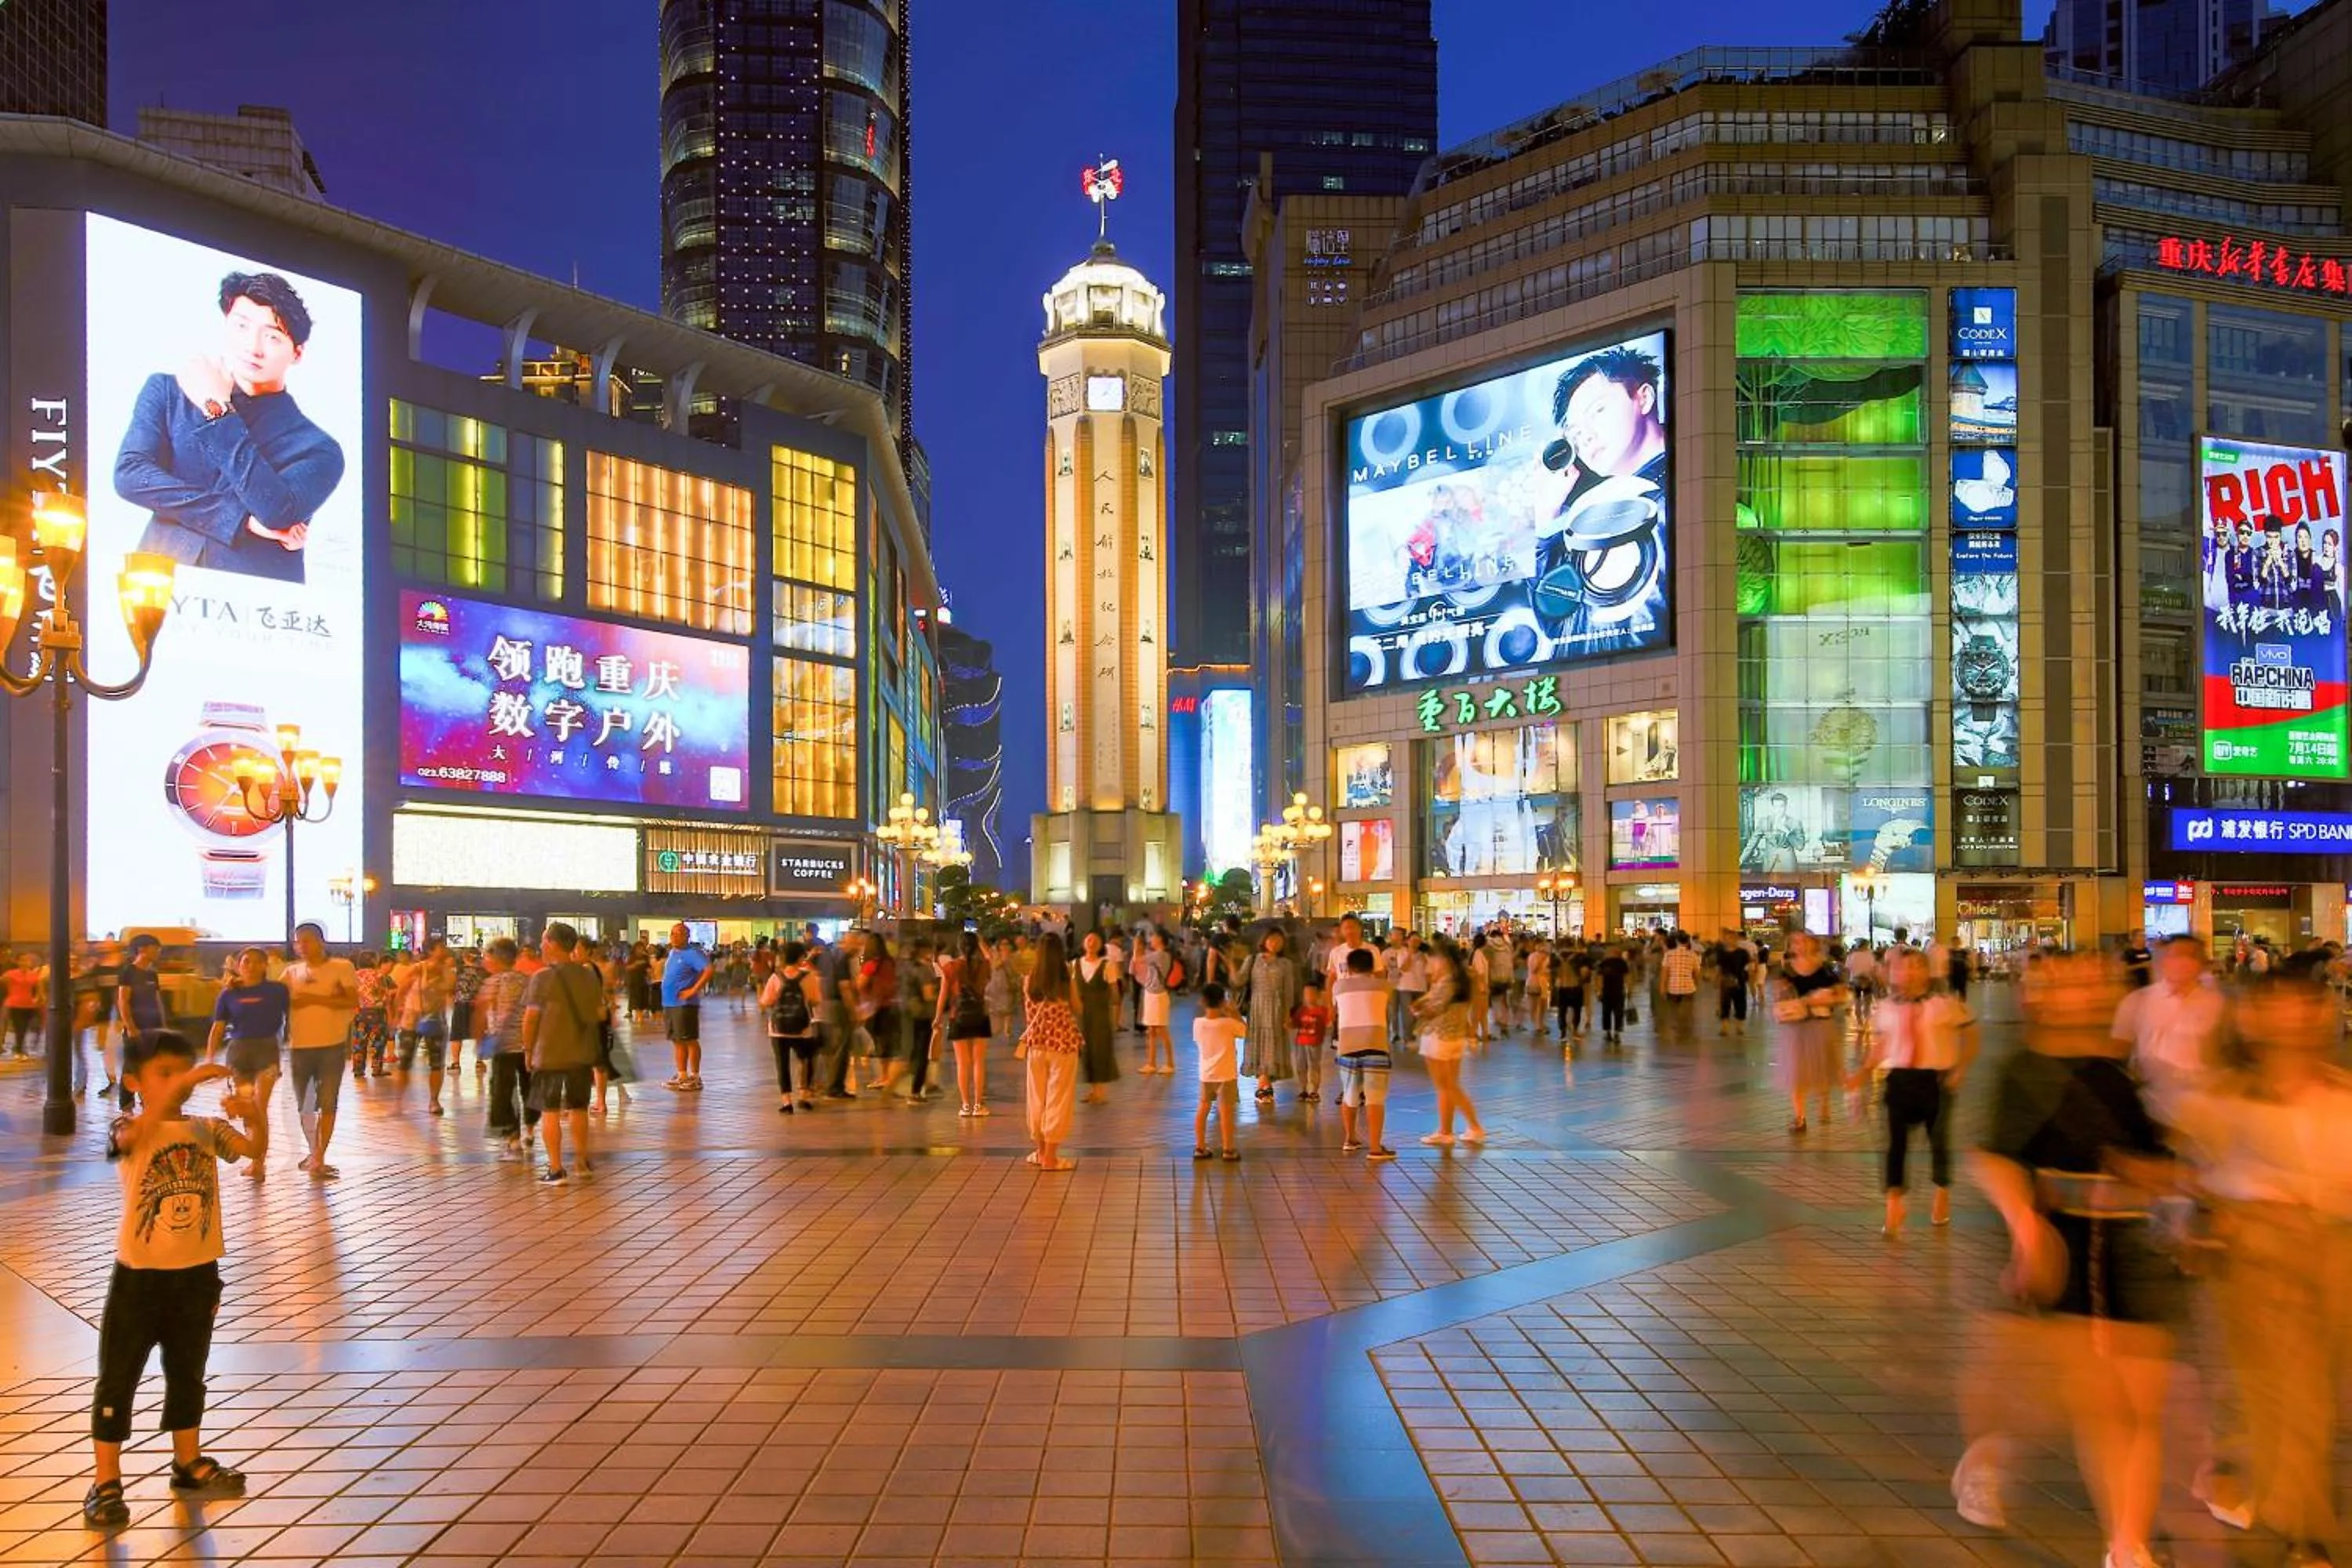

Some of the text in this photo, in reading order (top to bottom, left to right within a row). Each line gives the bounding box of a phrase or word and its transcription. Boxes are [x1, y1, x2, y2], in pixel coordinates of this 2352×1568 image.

[1958, 327, 2008, 339] CODEX
[1354, 424, 1533, 484] MAYBELLINE
[31, 397, 67, 554] FIY
[170, 595, 238, 623] YTA
[256, 605, 332, 638] 飞亚达
[2259, 648, 2287, 659] vivo
[486, 634, 681, 702] 领跑重庆
[487, 690, 681, 753] 数字户外
[1863, 797, 1927, 808] LONGINES
[2221, 818, 2285, 840] 浦发银行
[2288, 822, 2352, 840] SPD BAN
[781, 858, 845, 870] STARBUCKS
[793, 869, 833, 879] COFFEE
[1739, 887, 1796, 901] agen-Dazs
